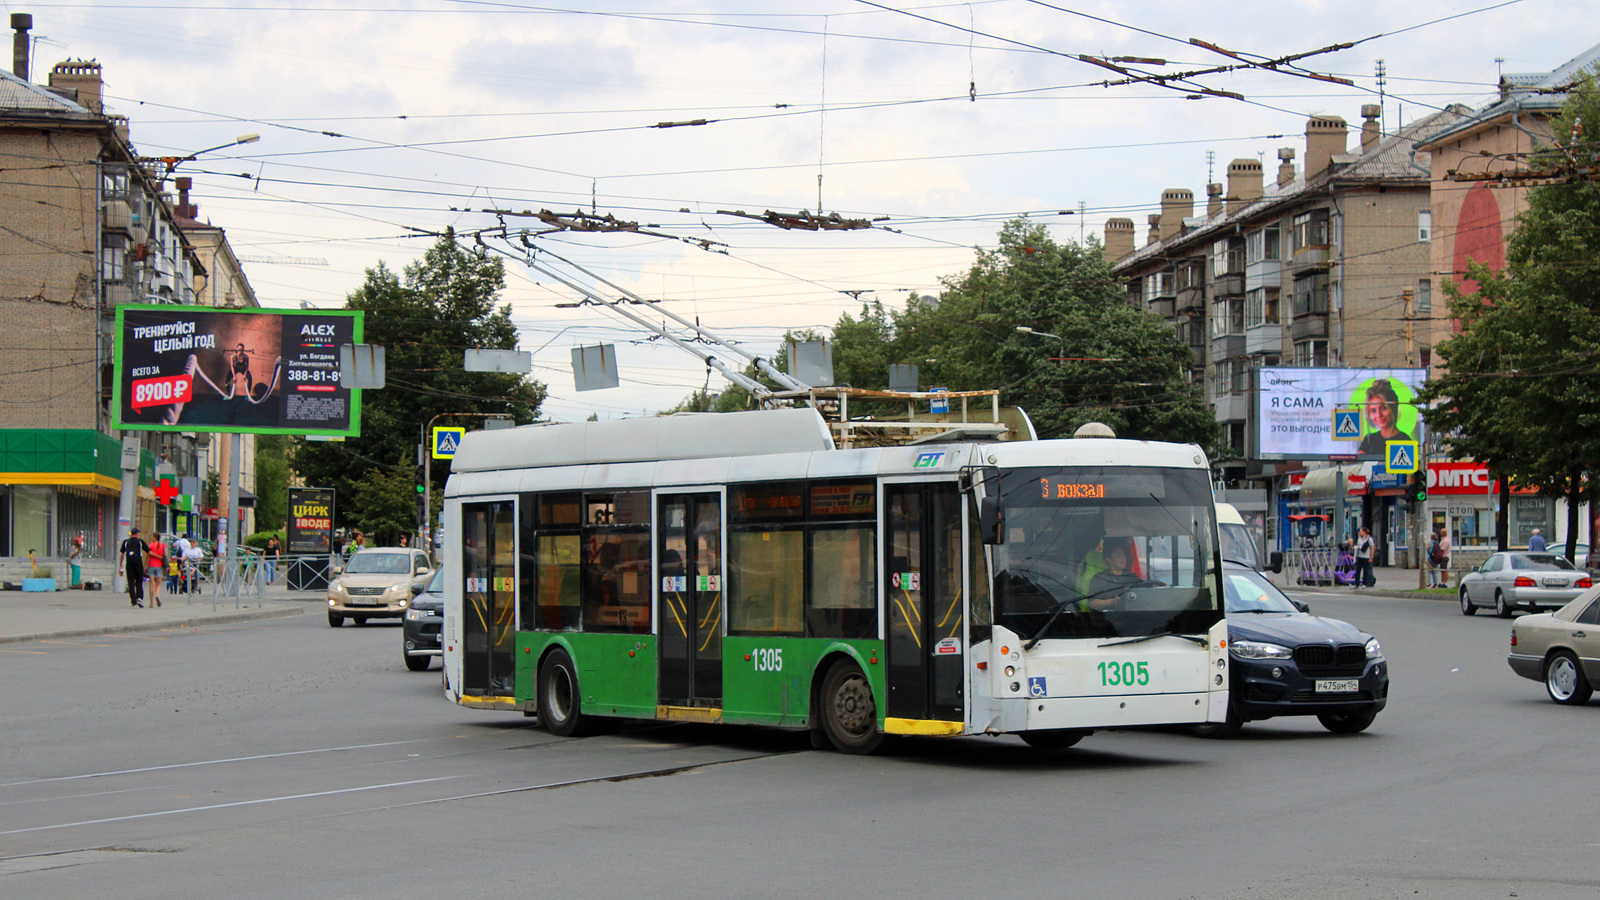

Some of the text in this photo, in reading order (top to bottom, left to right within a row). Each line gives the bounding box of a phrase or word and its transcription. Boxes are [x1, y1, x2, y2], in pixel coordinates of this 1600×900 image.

[133, 321, 195, 339] ТРЕНИРУЙСЯ
[300, 324, 336, 336] ALEX
[154, 333, 215, 354] ЦЕЛЫЙ ГОД
[309, 352, 335, 360] Богдана
[132, 365, 160, 377] ВСЕГО ЗА
[288, 370, 341, 381] 388-81-8
[135, 381, 172, 402] 8900
[1271, 397, 1324, 408] Я САМА
[1438, 469, 1488, 487] МТС
[293, 505, 328, 517] ЦИРК
[301, 518, 330, 529] ВОДЕ
[752, 648, 782, 671] 1305
[1097, 661, 1150, 686] 1305
